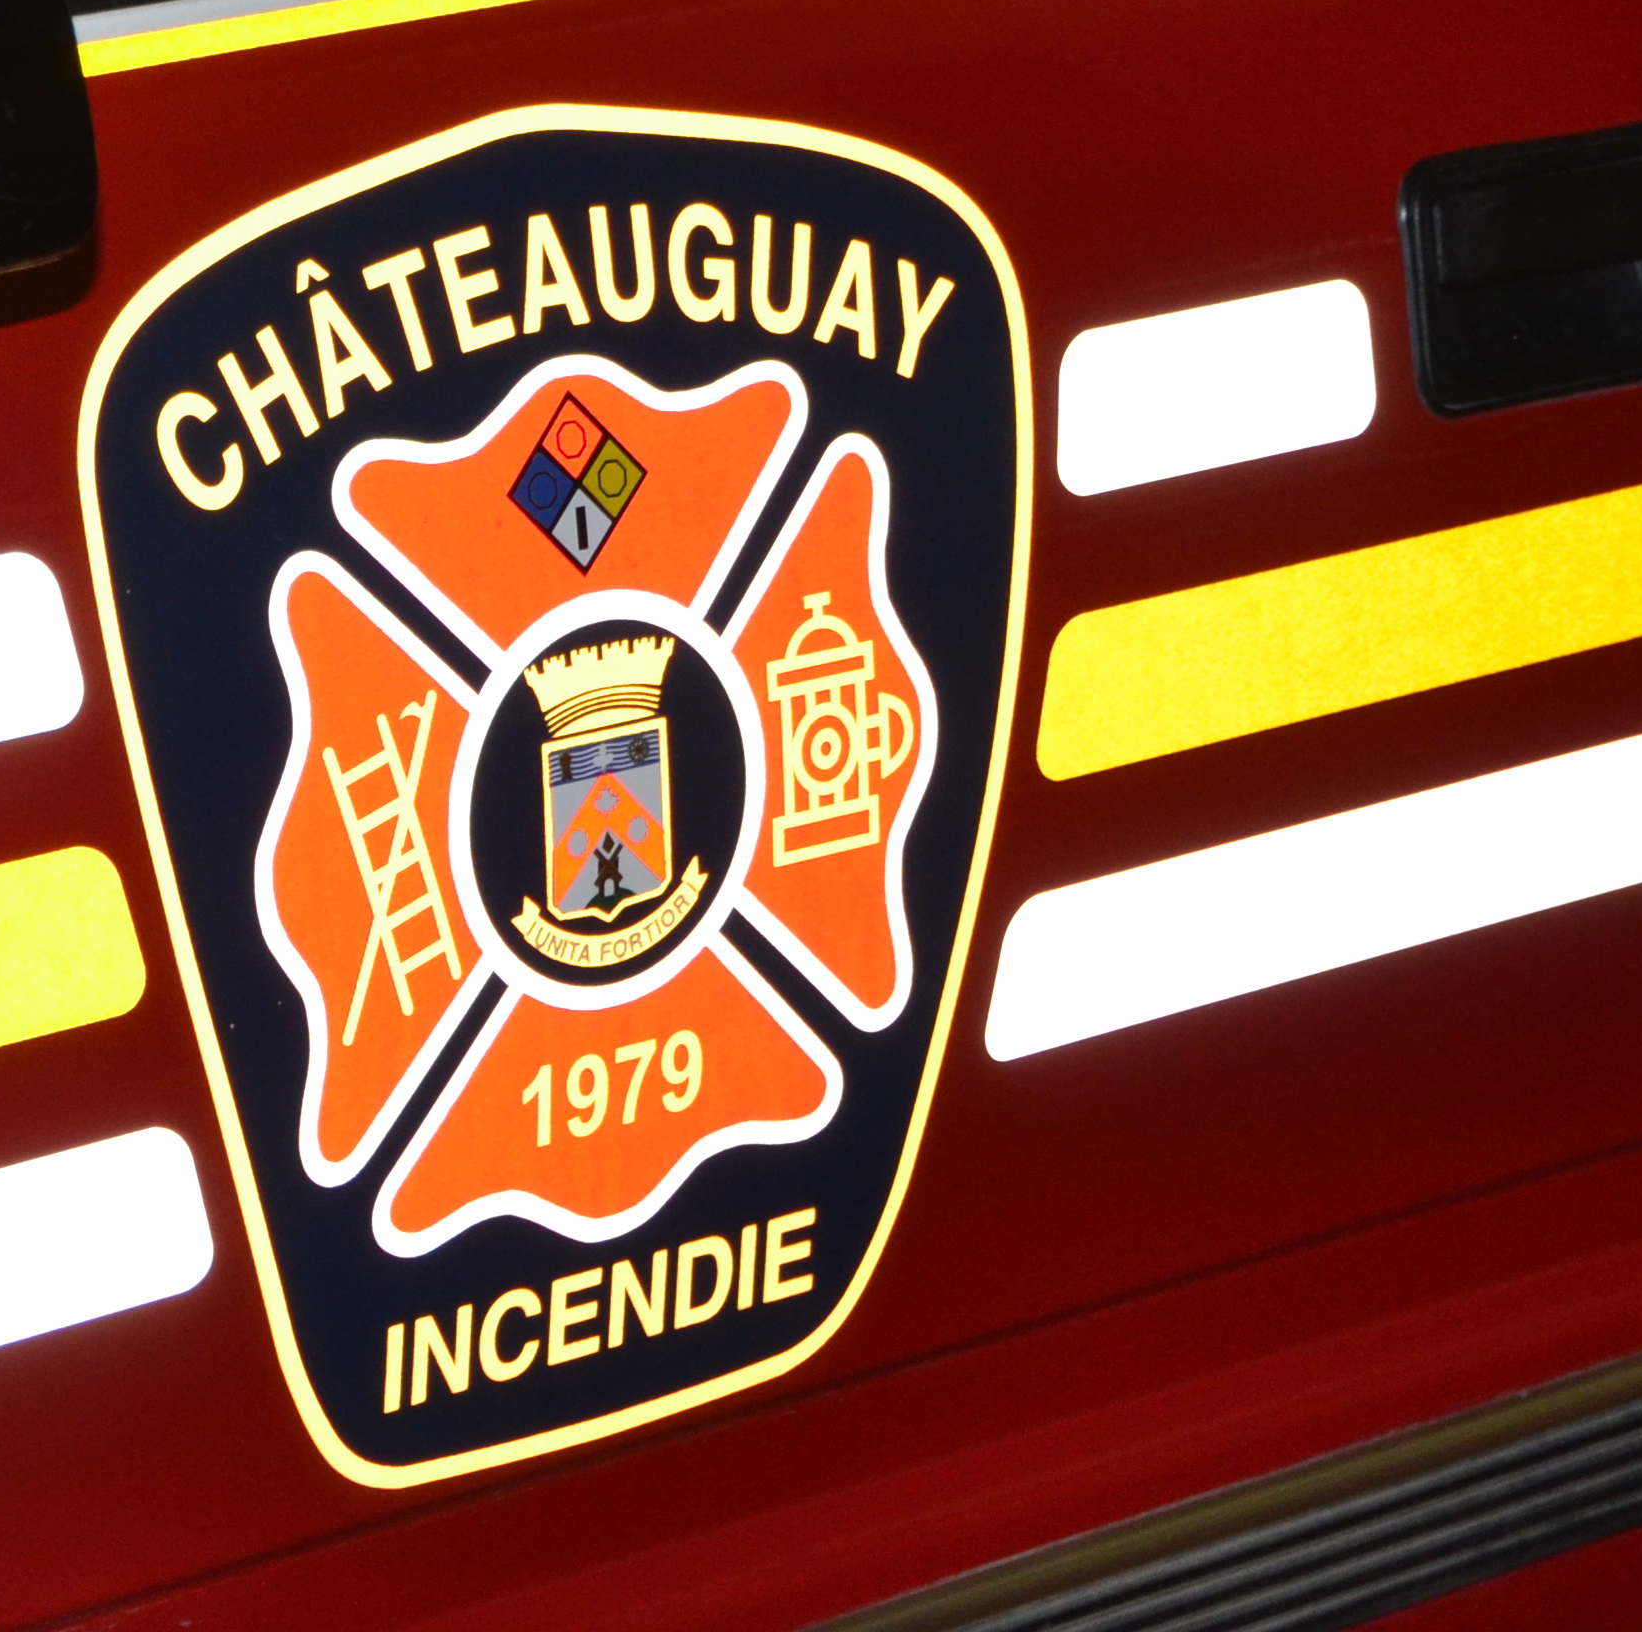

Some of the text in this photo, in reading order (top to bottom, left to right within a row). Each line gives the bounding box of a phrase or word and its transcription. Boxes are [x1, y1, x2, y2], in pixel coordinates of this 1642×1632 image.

[156, 203, 955, 511] CHÂTEAUGUAY
[534, 894, 690, 964] UNITA FORTIOR
[522, 1029, 703, 1148] 1979
[383, 1207, 816, 1414] INCENDIE
